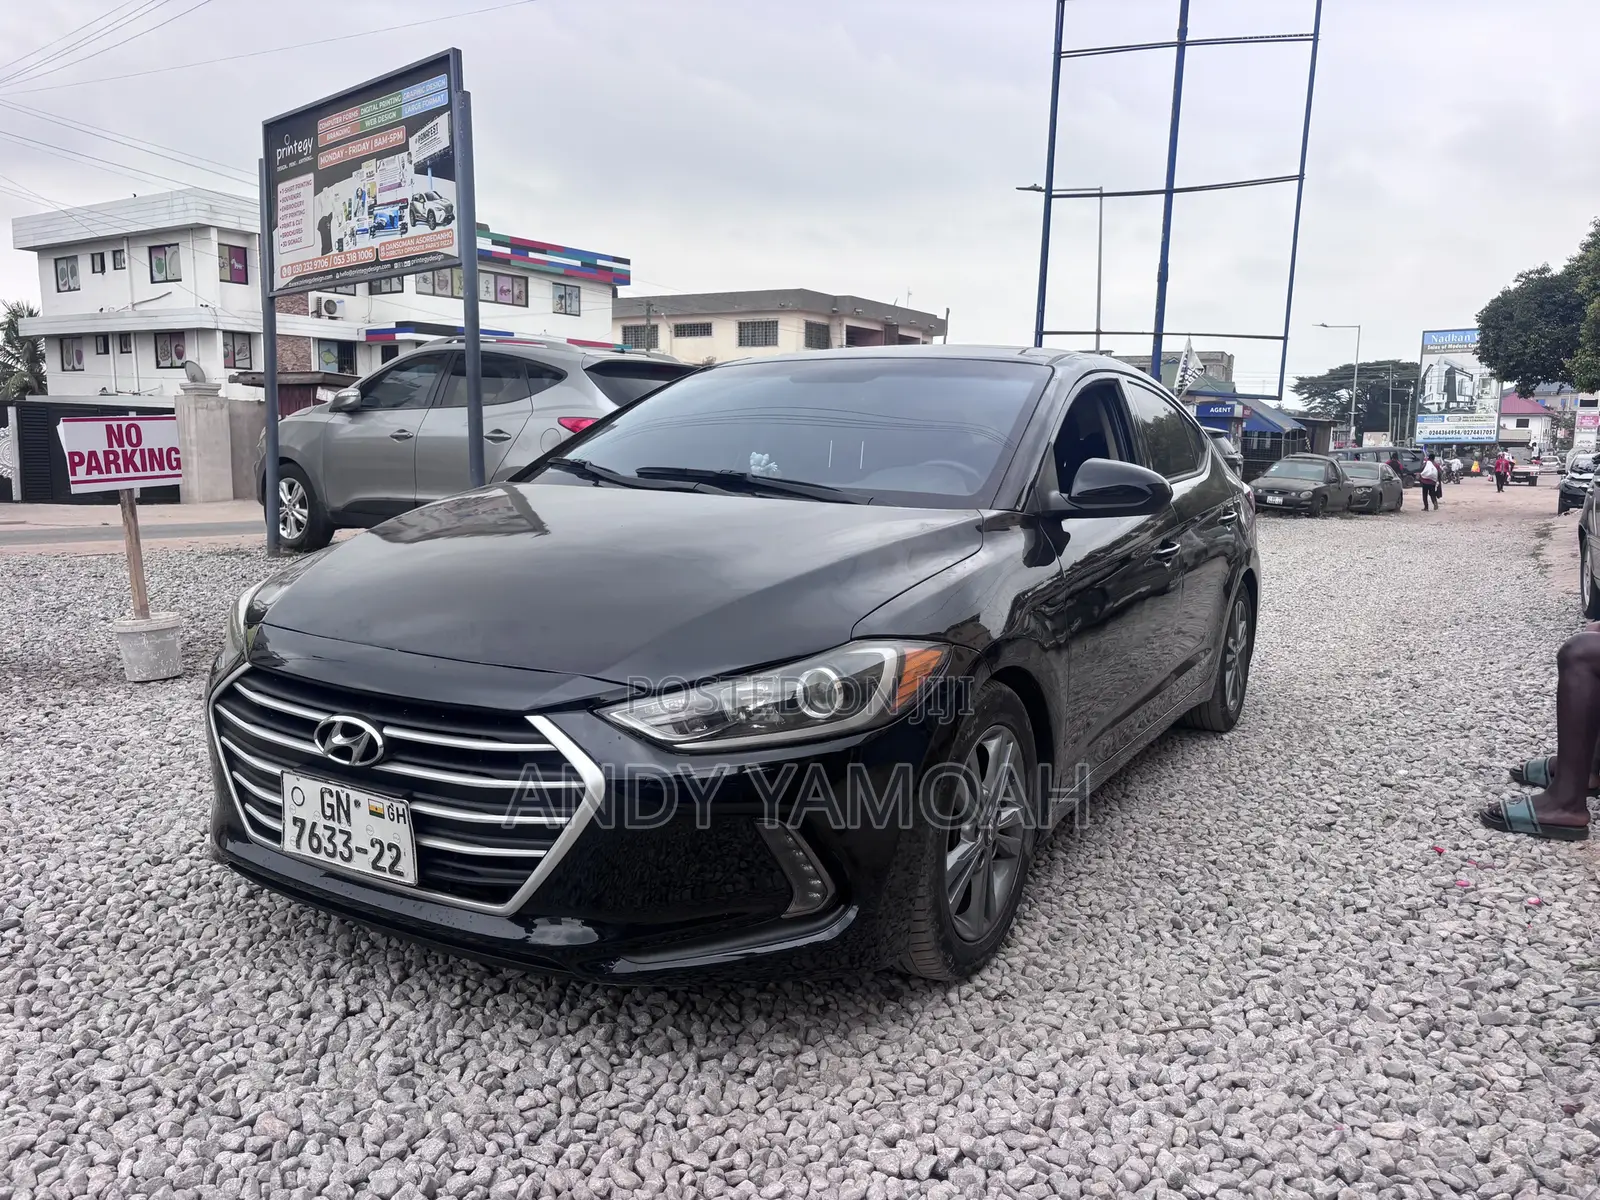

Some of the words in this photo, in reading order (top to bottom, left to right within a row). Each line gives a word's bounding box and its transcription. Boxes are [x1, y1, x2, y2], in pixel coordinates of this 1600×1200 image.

[403, 86, 425, 100] GRAPHIC
[425, 78, 446, 93] DESIGN
[360, 101, 378, 115] DIGITAL
[380, 95, 401, 110] PRINTING
[404, 102, 421, 114] LARGE
[422, 95, 444, 107] FORMAT
[319, 116, 342, 130] COMPUTER
[343, 110, 359, 123] FORMS
[365, 117, 378, 128] WEB
[379, 111, 397, 124] DESIGN
[327, 126, 351, 141] BRANDING
[276, 134, 313, 166] printegy
[320, 149, 344, 165] MONDAY
[348, 141, 370, 156] FRIDAY
[374, 130, 403, 147] 8AM-5PM
[295, 179, 312, 189] PRINTING
[281, 221, 292, 229] PRINT
[295, 218, 303, 226] CUT
[289, 209, 305, 219] PRINTING
[385, 238, 415, 251] DANSOMAN
[385, 248, 404, 257] DIRECTLY
[404, 245, 425, 254] OPPOSITE
[440, 239, 453, 247] PIZZA
[292, 264, 302, 274] 030
[302, 262, 313, 271] 232
[313, 258, 328, 269] 9706
[333, 255, 345, 265] 053
[345, 252, 357, 263] 318
[357, 248, 373, 260] 1006
[411, 253, 444, 266] printegydesign
[1431, 333, 1471, 343] Nadkan
[105, 423, 143, 448] NO
[67, 447, 182, 476] PARKING
[320, 786, 351, 827] GN
[387, 804, 407, 824] GH
[292, 816, 404, 877] 7633-22
